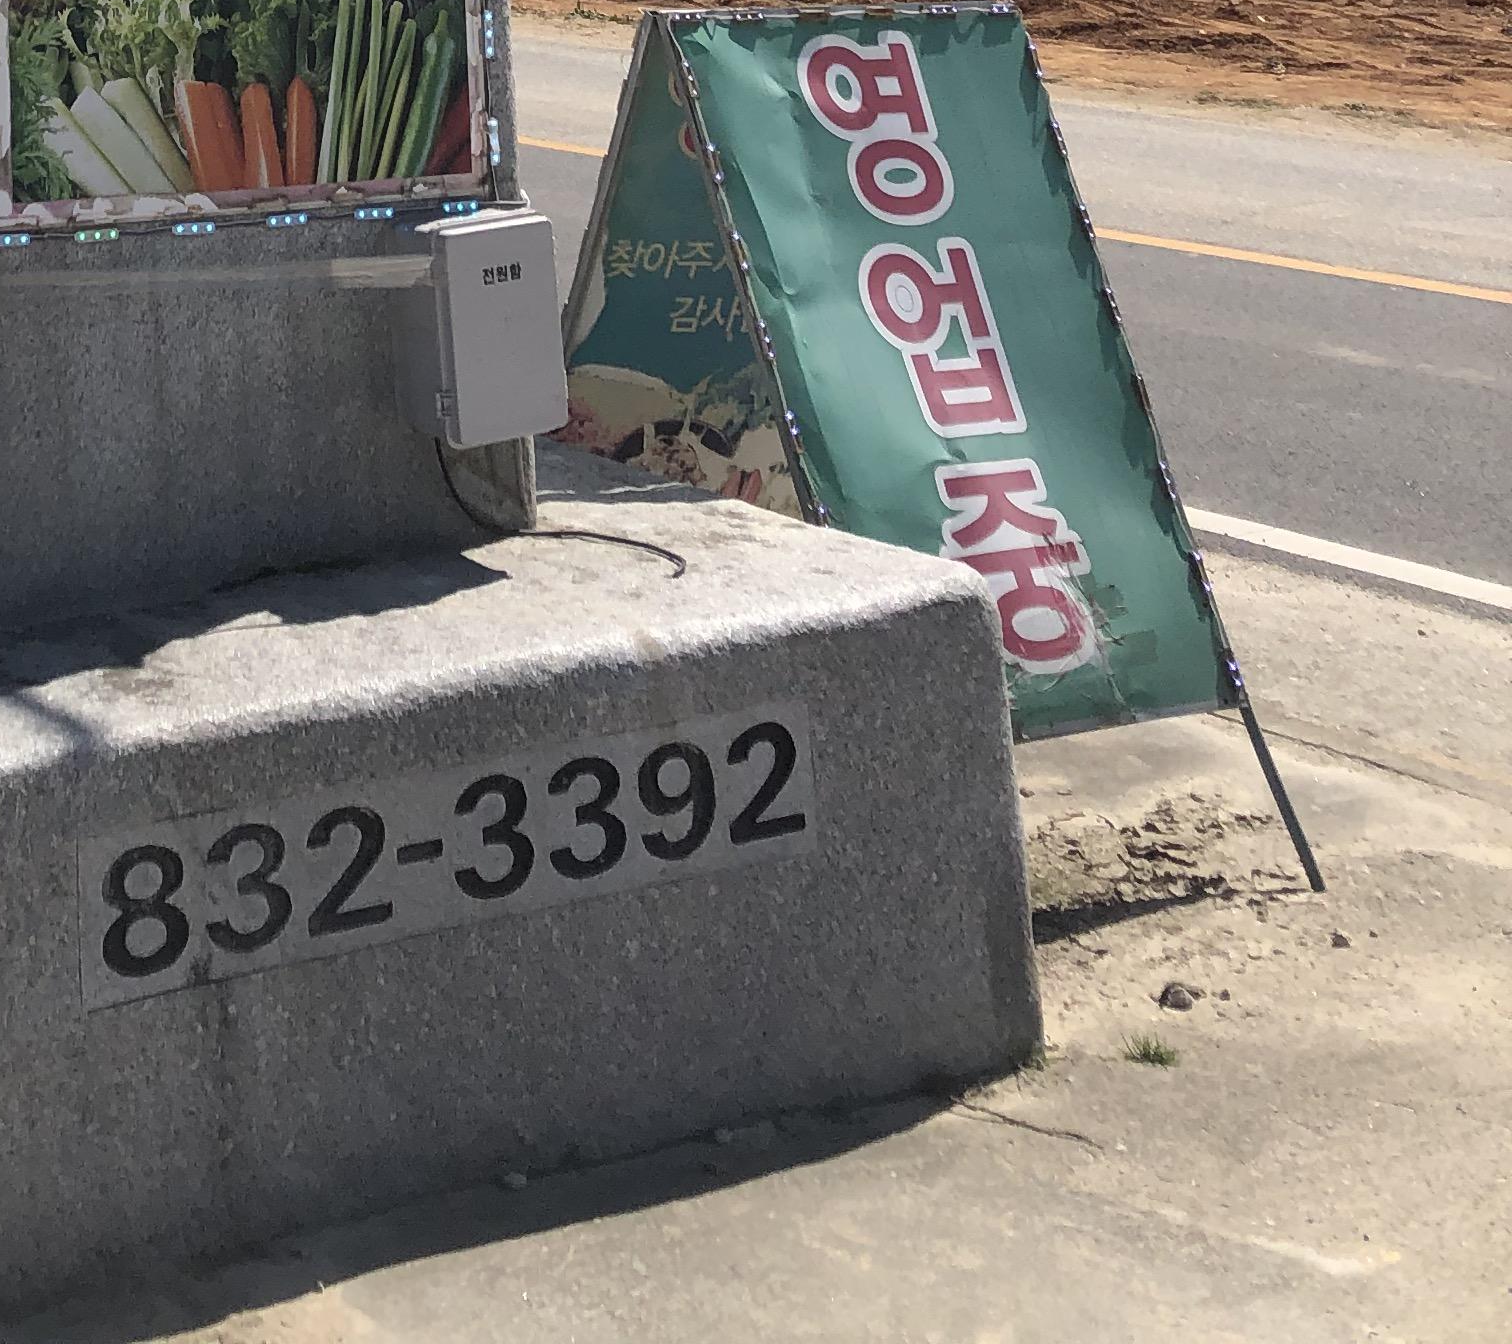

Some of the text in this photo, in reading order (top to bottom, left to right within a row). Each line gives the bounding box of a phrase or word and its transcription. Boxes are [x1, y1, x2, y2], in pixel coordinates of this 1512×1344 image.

[482, 261, 521, 286] 전원함
[669, 295, 749, 342] 감사
[797, 31, 1089, 675] 영업중
[100, 720, 808, 979] 832-3392
